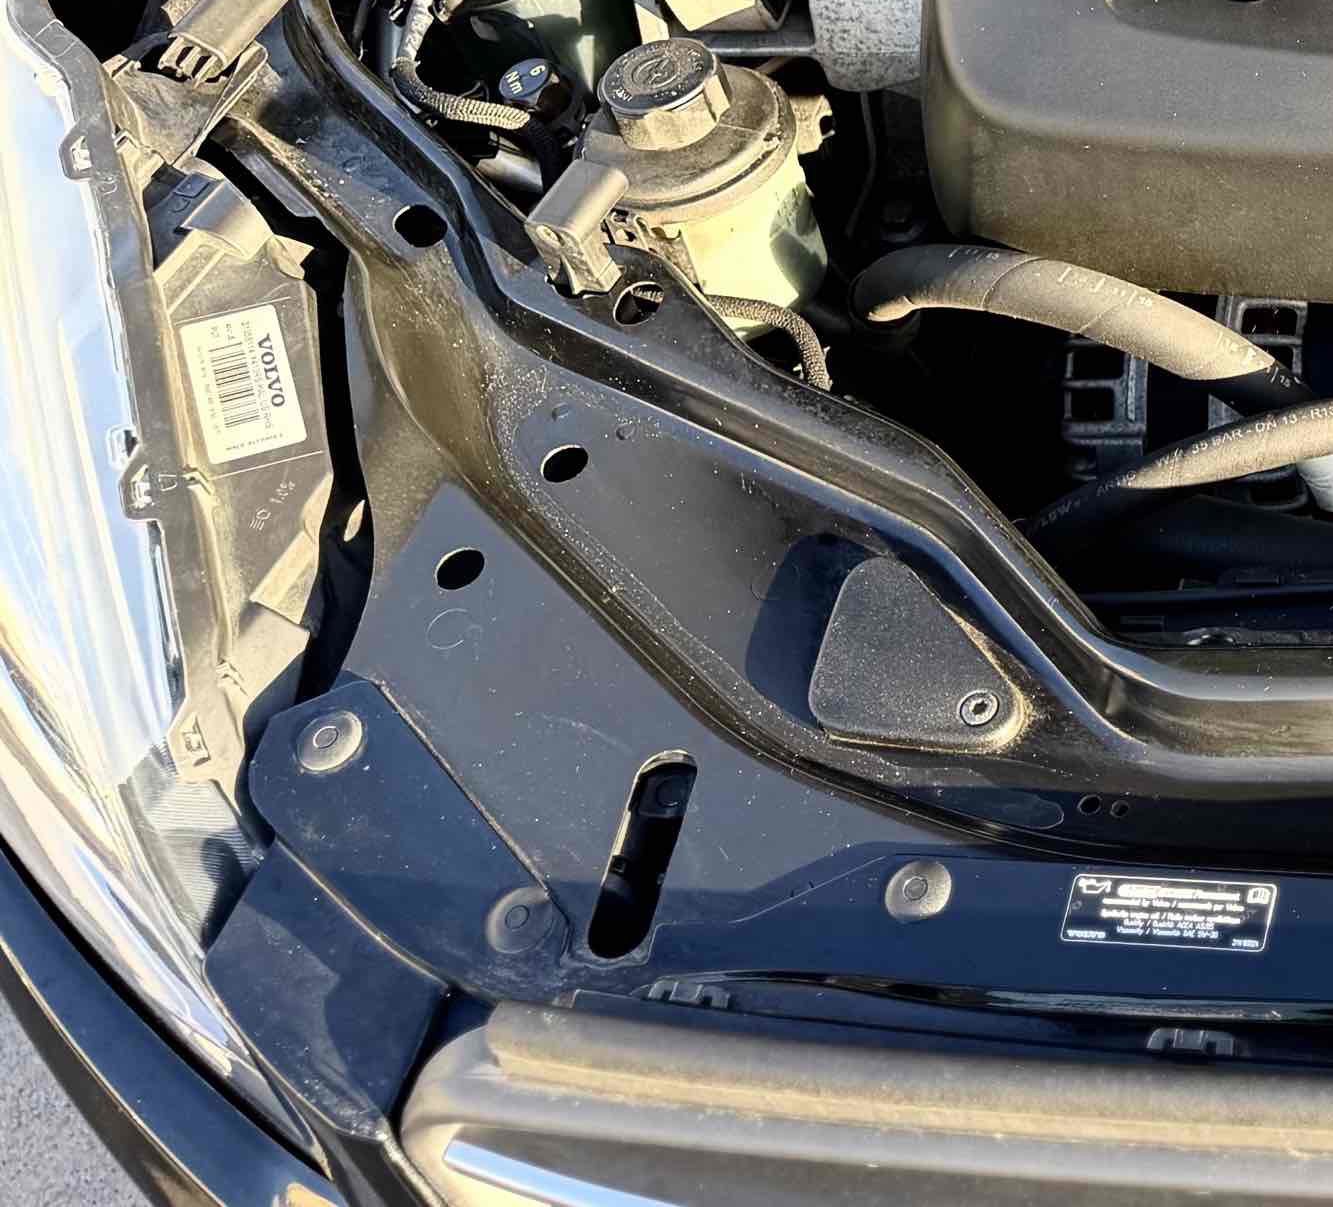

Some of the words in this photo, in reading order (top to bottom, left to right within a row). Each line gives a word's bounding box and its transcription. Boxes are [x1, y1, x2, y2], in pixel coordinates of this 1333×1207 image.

[529, 64, 546, 77] 6
[506, 71, 523, 94] Nm
[256, 333, 286, 408] VOLVO
